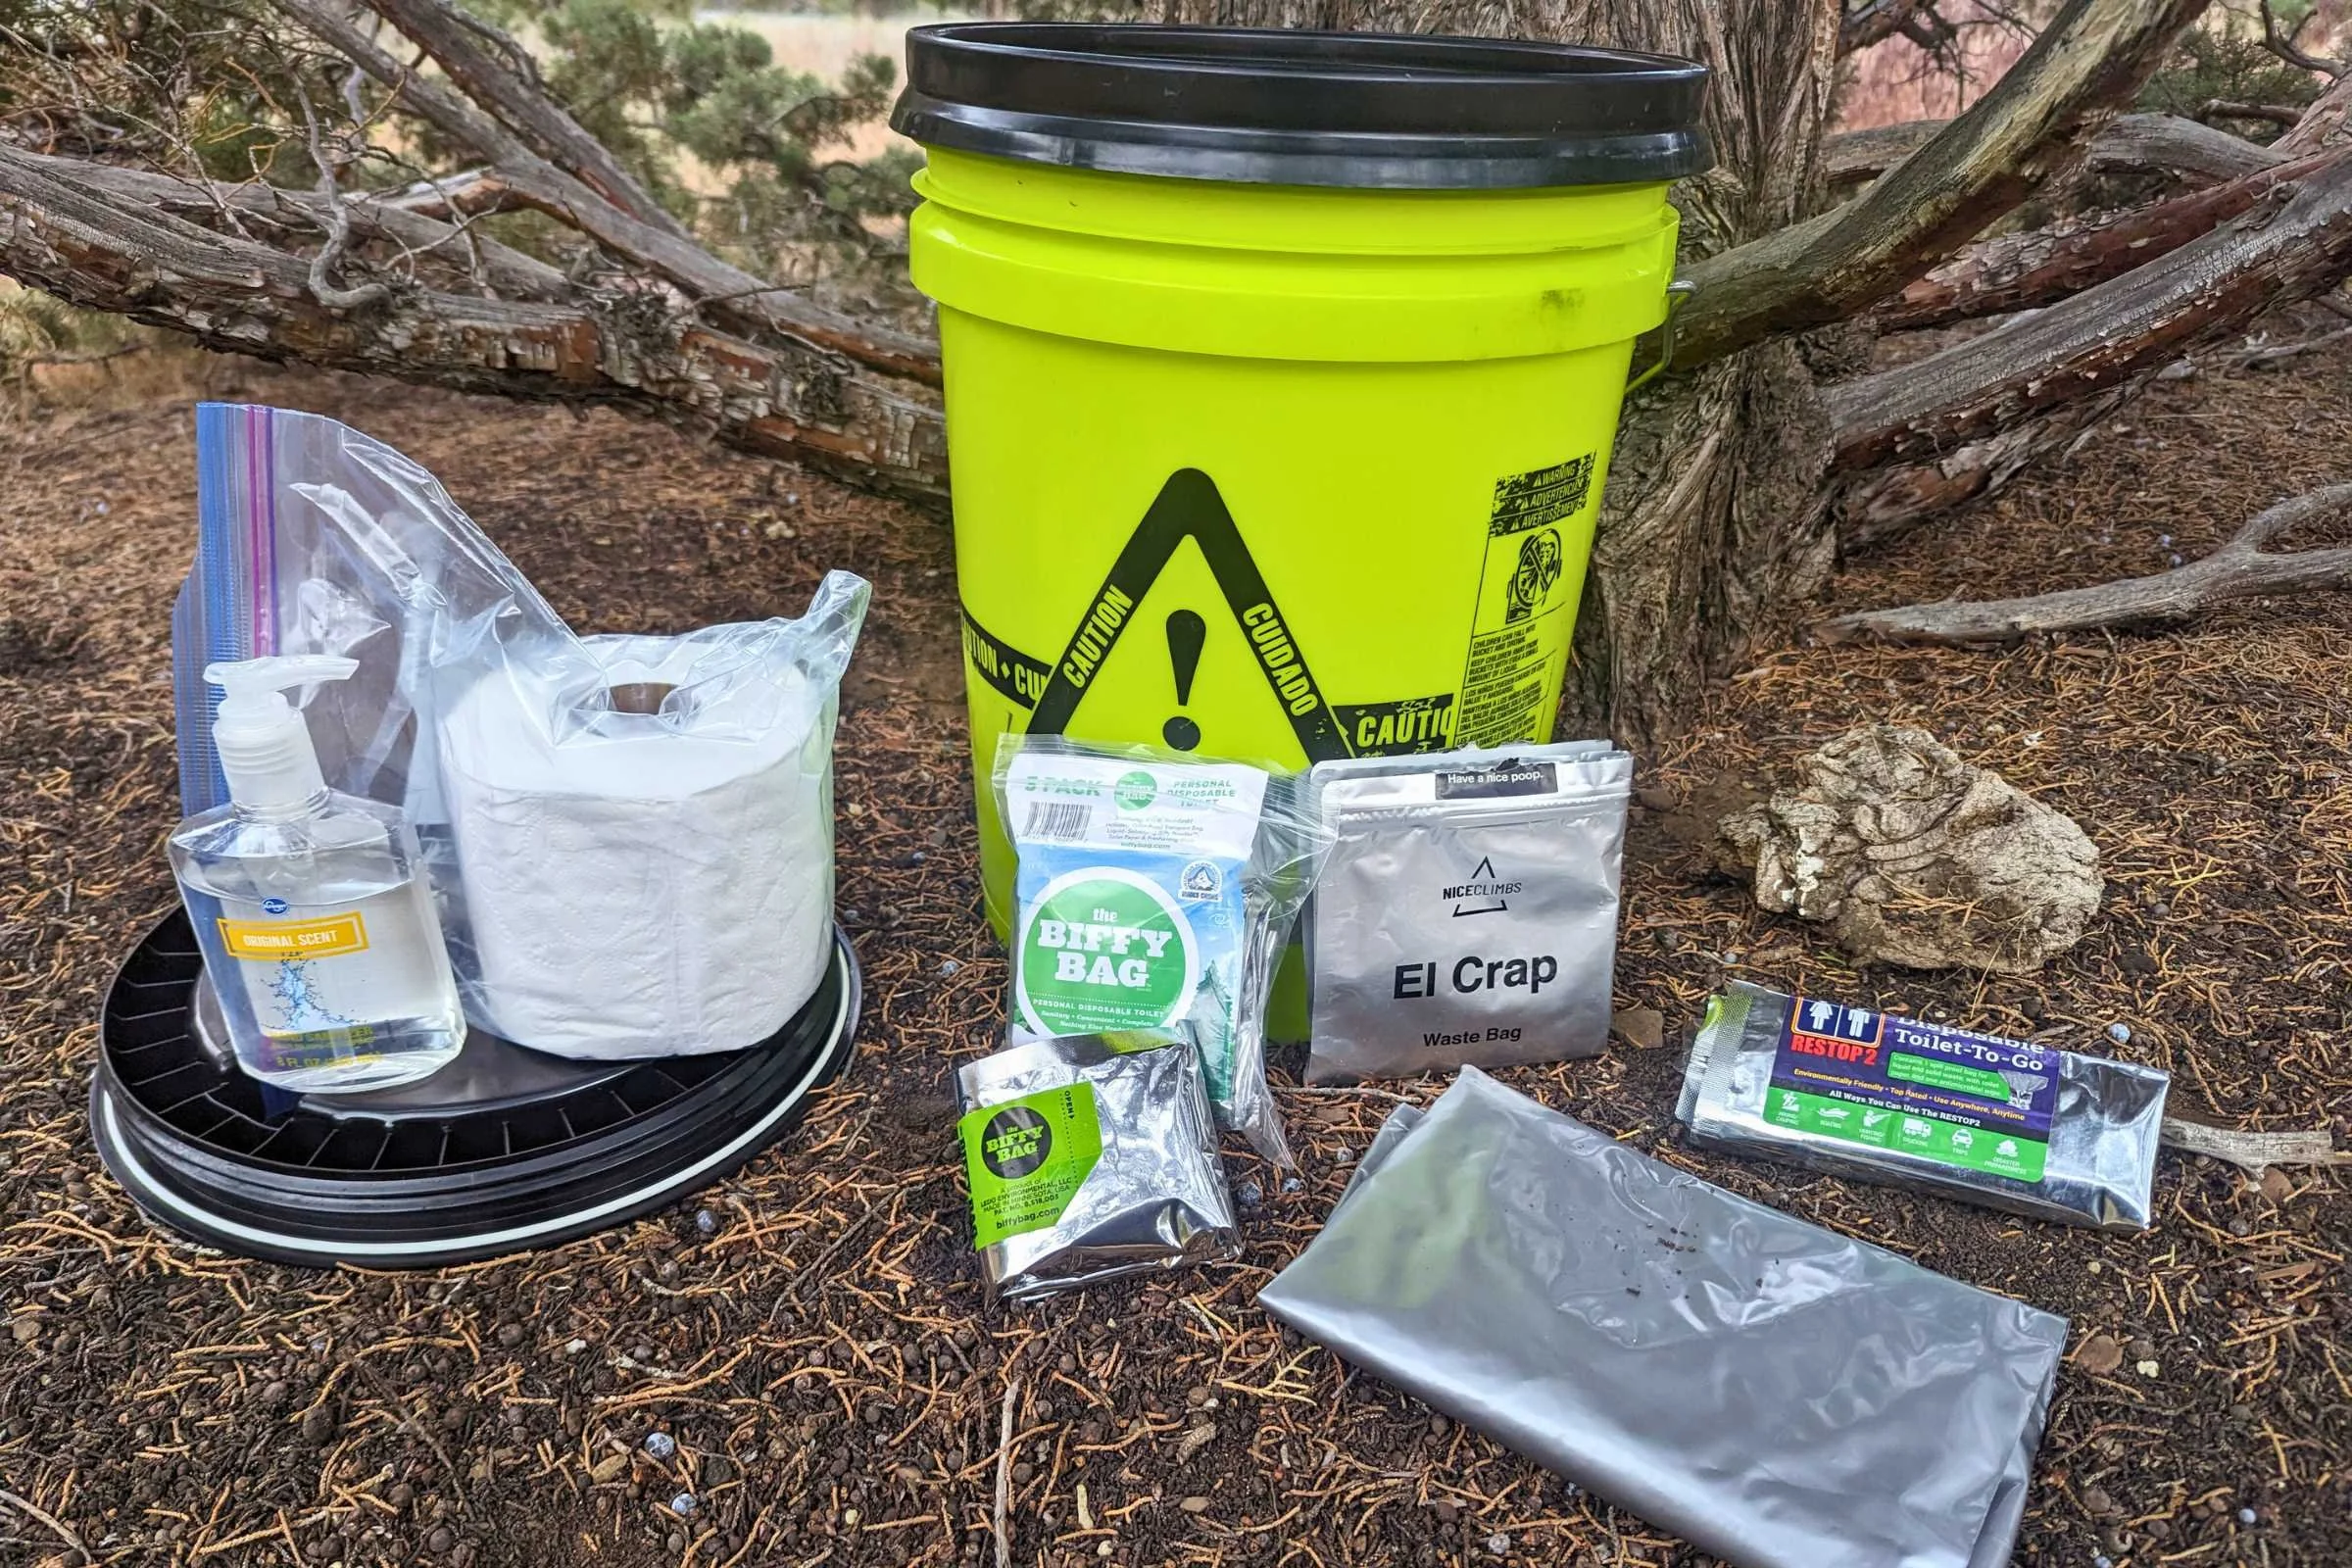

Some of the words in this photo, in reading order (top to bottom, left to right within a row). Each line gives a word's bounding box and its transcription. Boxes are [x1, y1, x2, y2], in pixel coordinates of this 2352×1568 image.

[1542, 463, 1576, 486] WARNING
[1063, 584, 1134, 688] CAUTION
[1243, 603, 1318, 717] CUIDADO
[1172, 779, 1232, 789] PERSONAL
[1446, 773, 1475, 784] Have
[1487, 772, 1508, 783] nice
[1511, 770, 1544, 783] poop.
[1167, 788, 1238, 799] DISPOSABLE
[1443, 882, 1522, 901] NICECLIMBS
[1093, 907, 1118, 924] the
[243, 933, 296, 949] ORIGINAL
[297, 929, 338, 947] SCENT
[1038, 918, 1173, 958] BIFFY
[1054, 951, 1150, 989] BAG
[1394, 961, 1437, 1000] El
[1452, 954, 1558, 995] Crap
[1033, 999, 1077, 1010] PERSONAL
[1078, 1004, 1131, 1016] DISPOSABLE
[1135, 1009, 1165, 1018] TOILET
[1422, 1030, 1481, 1048] Waste
[1486, 1027, 1522, 1043] Bag
[1894, 1028, 2044, 1071] Toilet-To-Go
[1064, 1090, 1075, 1114] OPEN
[1793, 1068, 1853, 1087] Environmentally
[1853, 1079, 1885, 1093] Friendly
[1889, 1087, 1904, 1097] Top
[1905, 1089, 1929, 1101] Rated
[1934, 1096, 1949, 1105] Use
[1950, 1099, 1991, 1114] Anywhere,
[1991, 1107, 2026, 1121] Anytime
[1829, 1089, 1842, 1099] All
[1843, 1092, 1867, 1103] Ways
[1868, 1098, 1884, 1107] You
[1886, 1101, 1902, 1110] Can
[1903, 1104, 1920, 1114] Use
[1921, 1107, 1938, 1118] The
[1939, 1111, 1982, 1127] RESTOP2
[986, 1125, 1044, 1153] BIFFY
[996, 1141, 1039, 1163] BAG
[1054, 1185, 1070, 1194] USA
[1057, 1177, 1072, 1186] LLC
[996, 1206, 1060, 1230] biffybag.com
